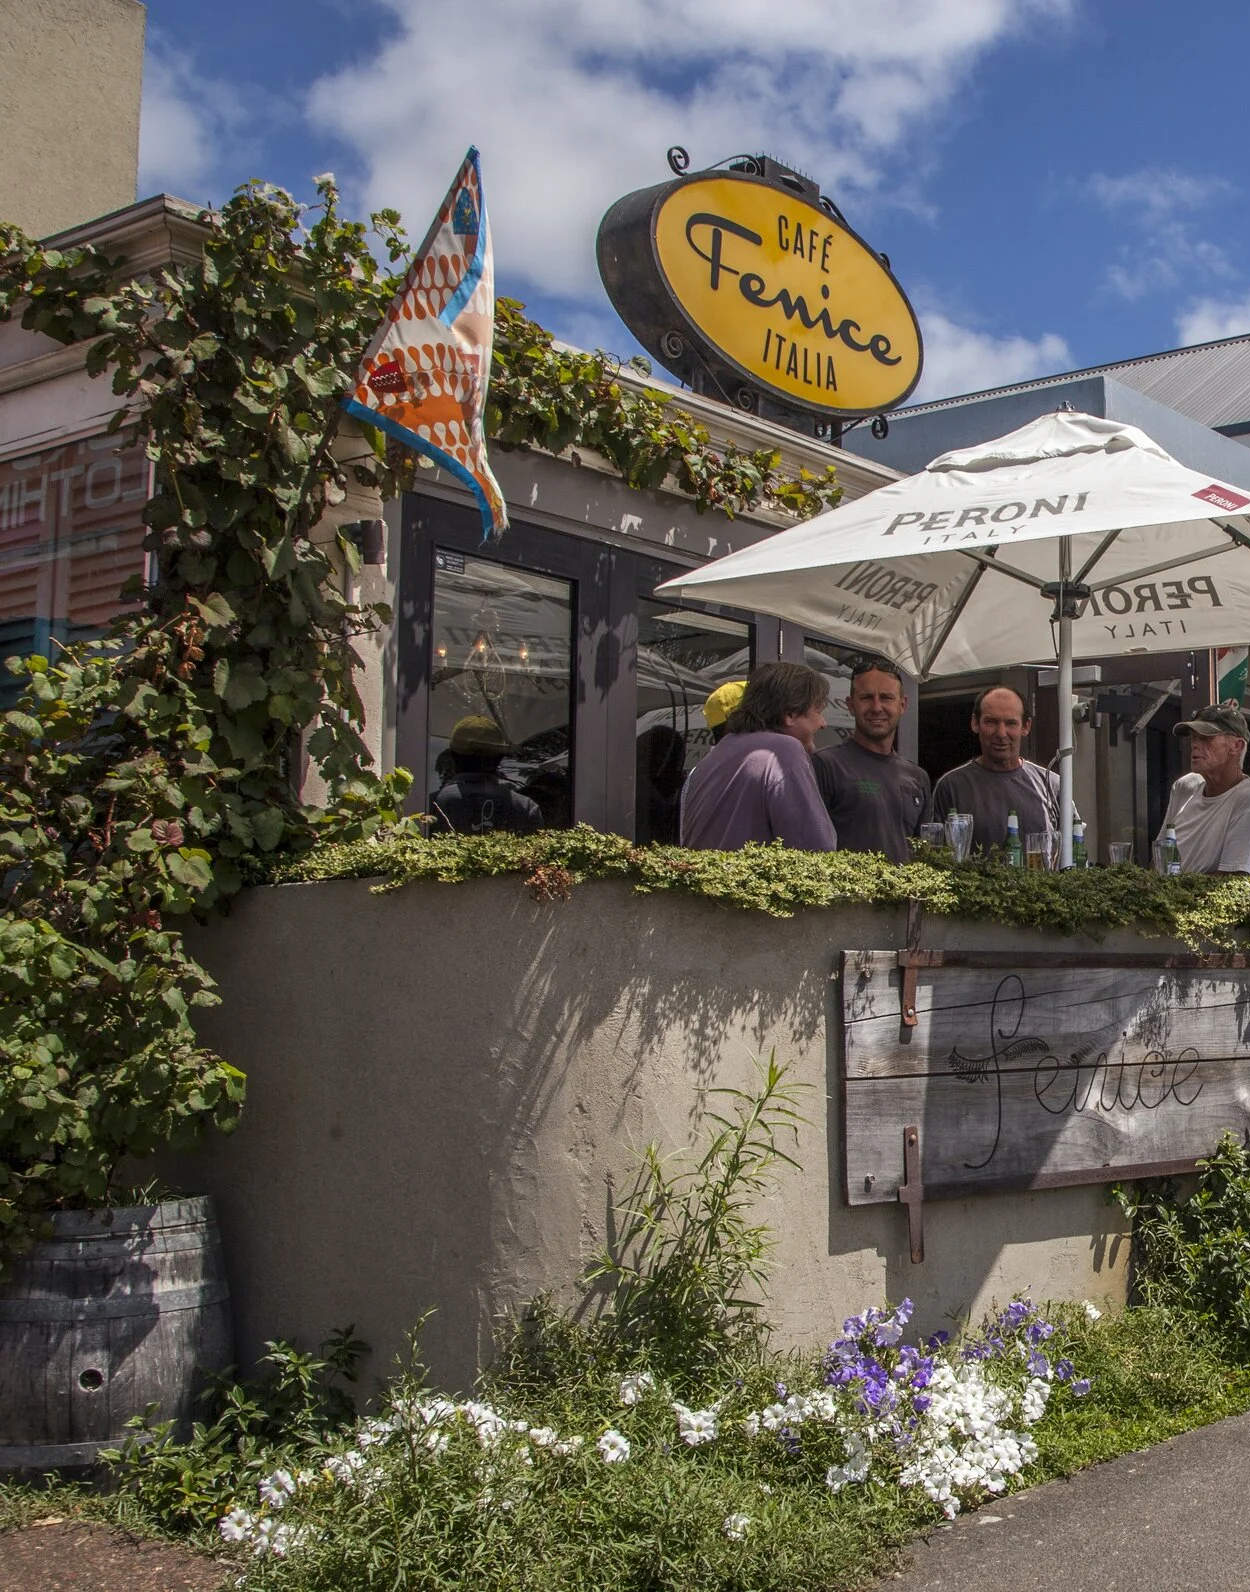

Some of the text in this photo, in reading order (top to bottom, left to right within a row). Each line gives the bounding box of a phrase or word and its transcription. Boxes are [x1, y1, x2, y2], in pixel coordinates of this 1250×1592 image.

[777, 214, 834, 274] CAFÉ
[685, 212, 902, 366] Fenice
[762, 328, 838, 392] ITALIA
[881, 490, 1091, 537] PERONI
[1203, 492, 1238, 510] PERONI
[922, 524, 1027, 546] ITALY
